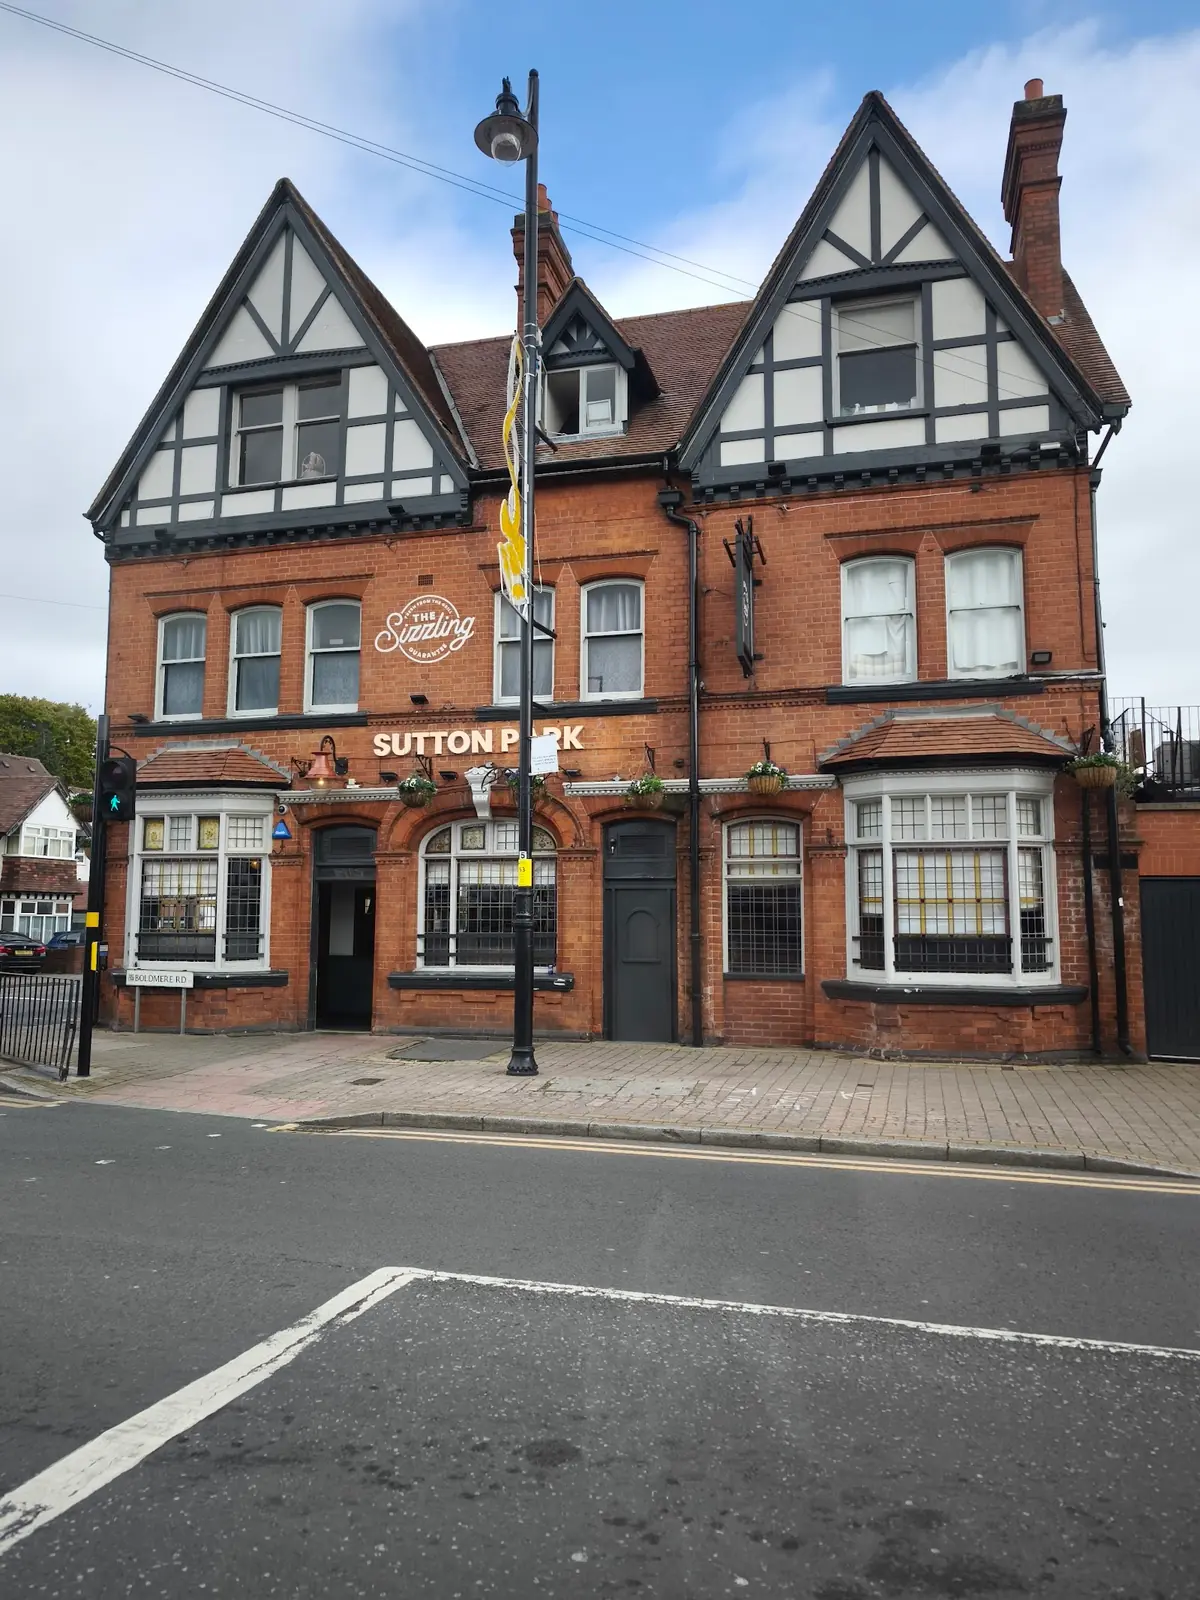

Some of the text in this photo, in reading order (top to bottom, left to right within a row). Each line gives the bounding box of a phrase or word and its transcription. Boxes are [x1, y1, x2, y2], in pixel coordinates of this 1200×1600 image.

[412, 611, 436, 622] THE
[375, 612, 476, 653] Sizzling
[408, 643, 448, 658] GUARANTEE
[373, 725, 584, 757] SUTTON PRK
[135, 974, 173, 983] BOLDMERE
